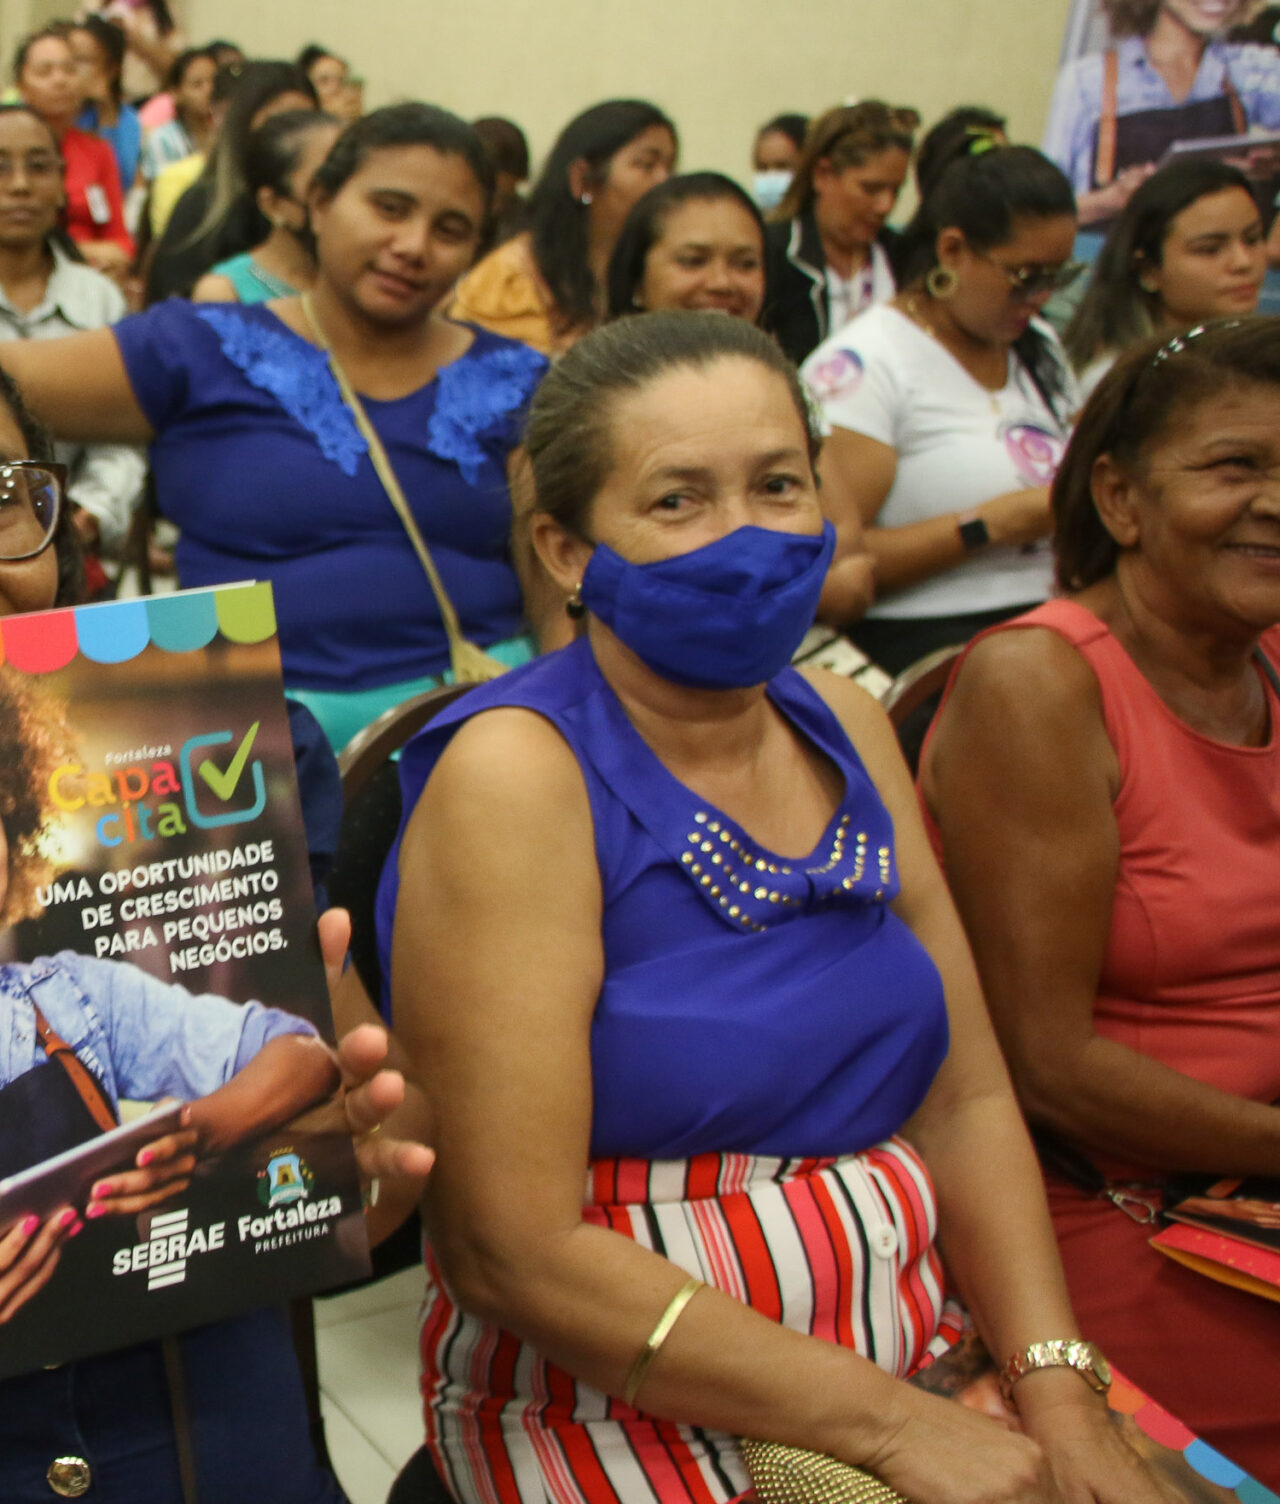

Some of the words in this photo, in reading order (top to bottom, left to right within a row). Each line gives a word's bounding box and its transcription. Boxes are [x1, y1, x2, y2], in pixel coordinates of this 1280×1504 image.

[104, 744, 172, 766] Fortaleza
[48, 760, 182, 812] Capa
[95, 800, 187, 848] cita
[35, 877, 94, 907] UMA
[98, 840, 275, 896] OPORTUNIDADE
[81, 907, 114, 931] DE
[120, 870, 279, 922] CRESCIMENTO
[94, 926, 158, 958] PARA
[163, 898, 283, 944] PEQUENOS
[169, 928, 289, 973] NEGÓCIOS.
[238, 1195, 342, 1242] Fortaleza
[255, 1222, 330, 1255] PREFEITURA
[112, 1221, 226, 1276] SEBRAE
